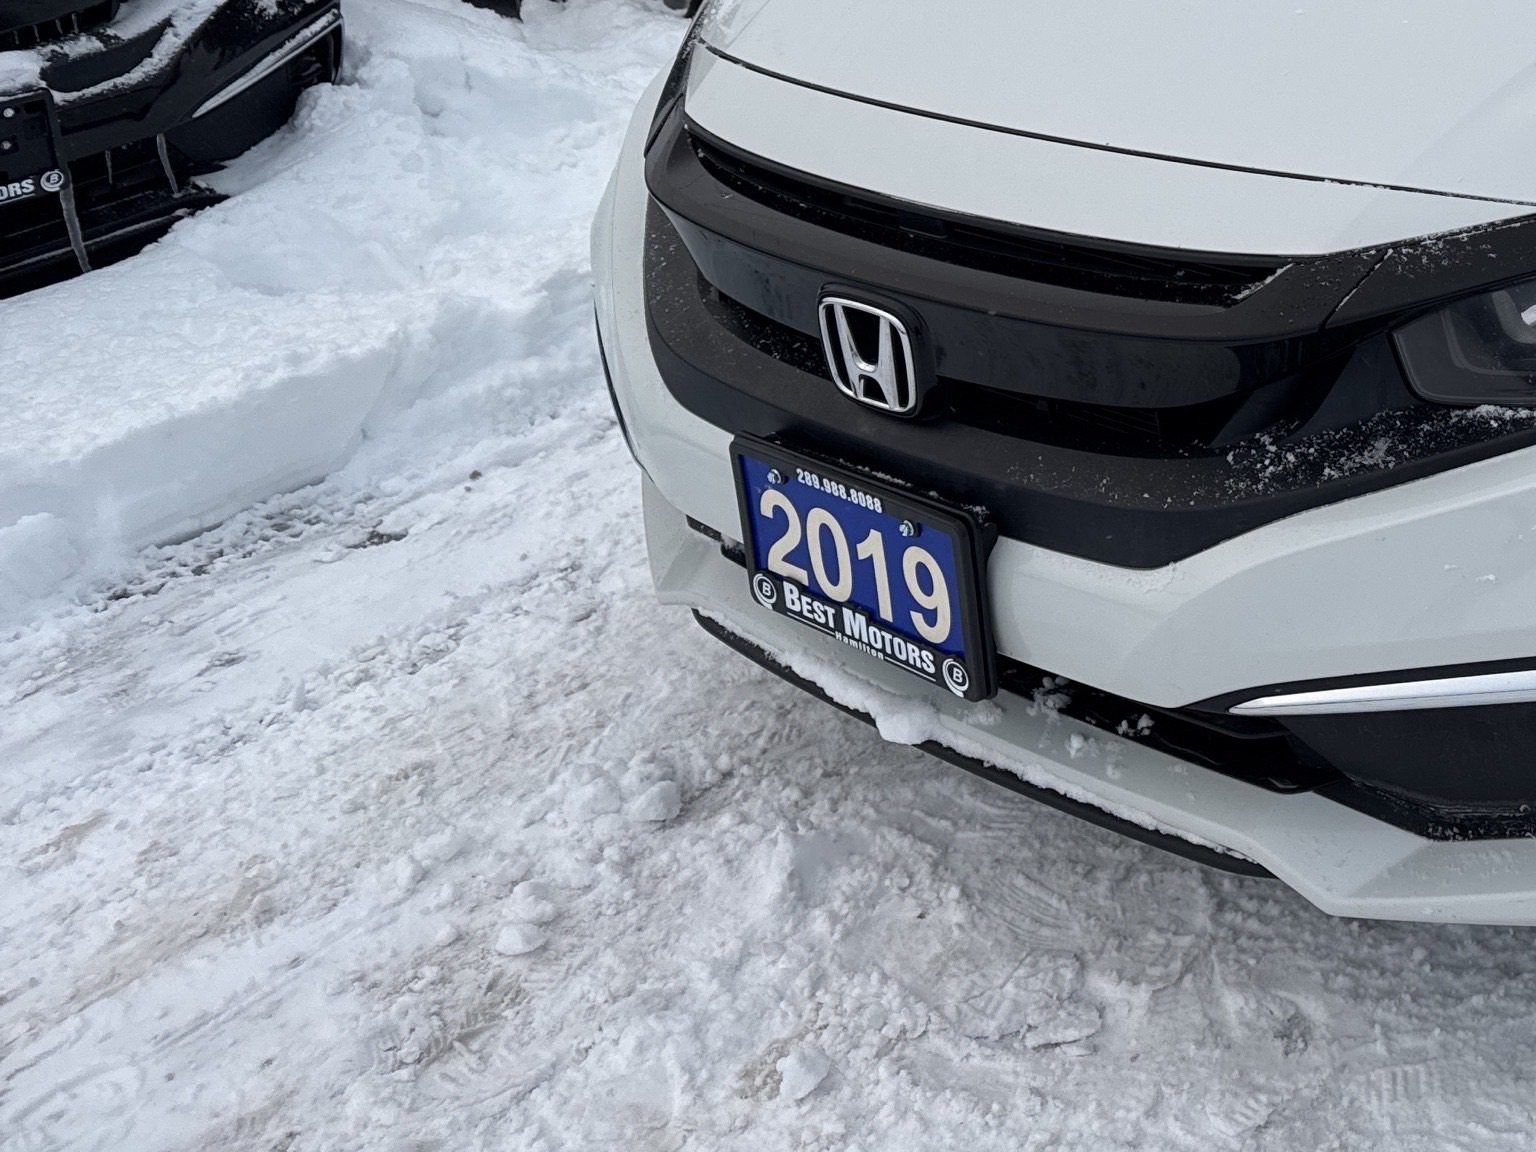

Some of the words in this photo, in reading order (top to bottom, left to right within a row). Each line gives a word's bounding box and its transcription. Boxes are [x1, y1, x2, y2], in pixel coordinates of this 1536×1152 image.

[795, 468, 883, 514] 289.988.8088
[760, 489, 951, 644] 2019
[835, 631, 885, 661] Hamilton
